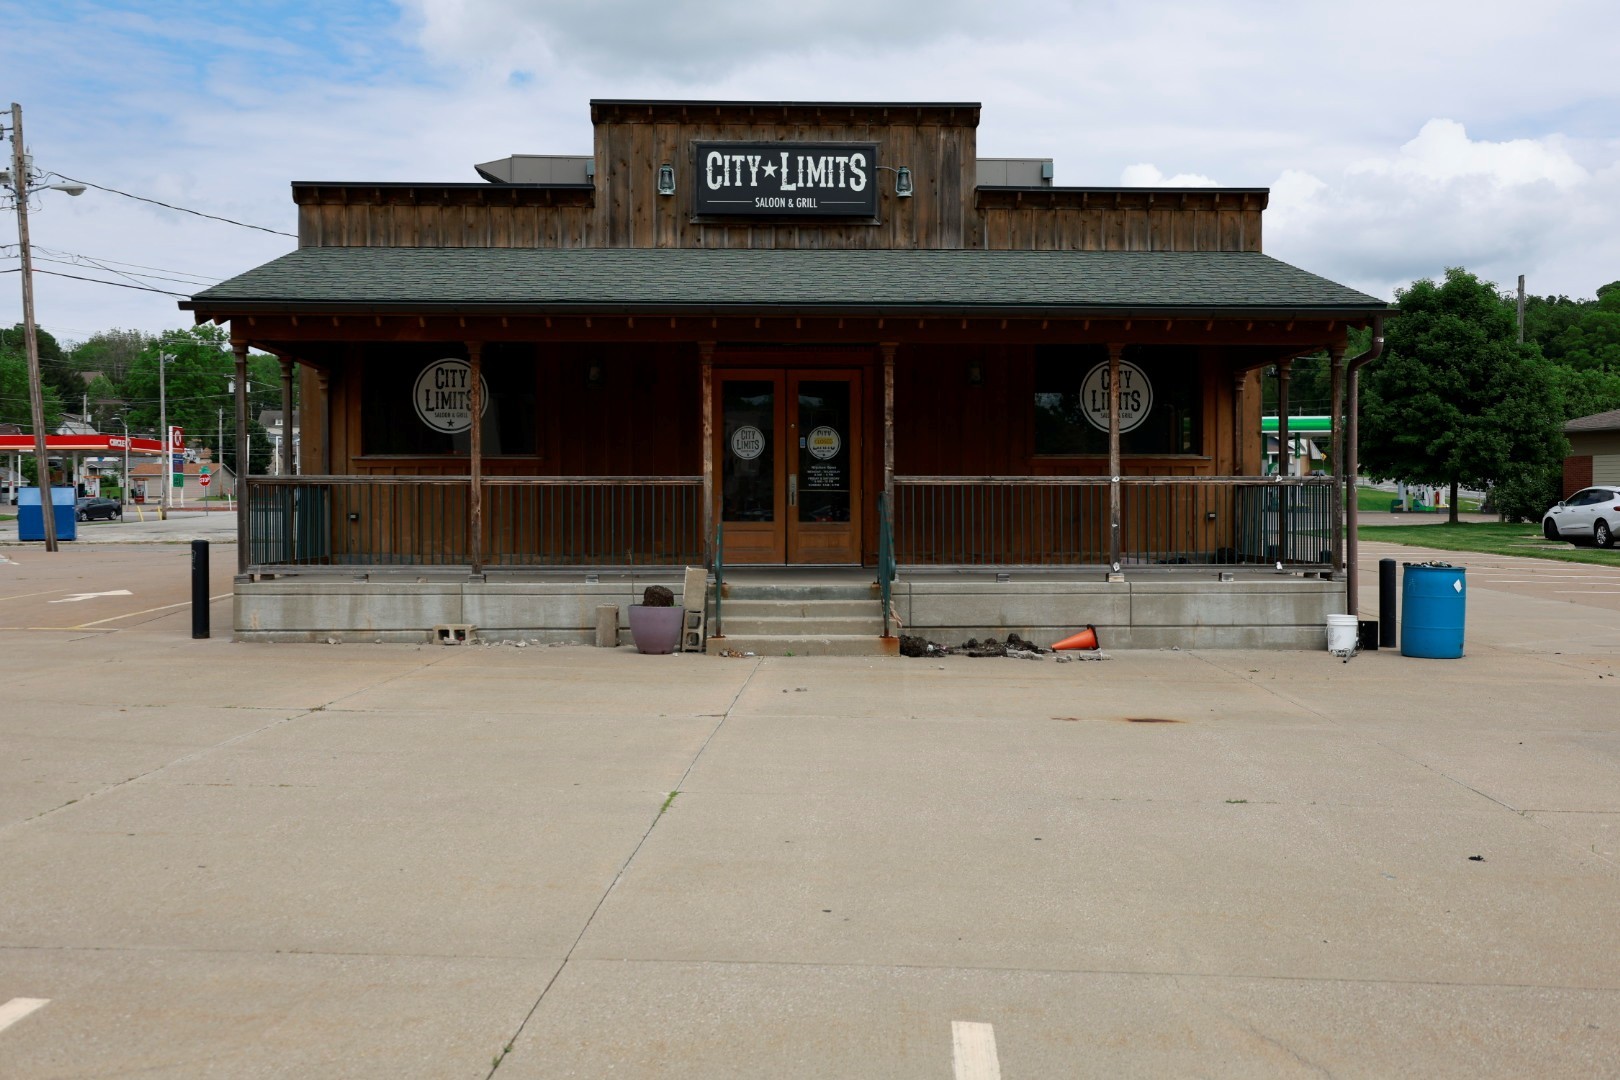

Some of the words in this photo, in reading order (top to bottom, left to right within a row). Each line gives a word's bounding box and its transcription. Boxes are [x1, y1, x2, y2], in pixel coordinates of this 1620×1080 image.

[706, 151, 761, 190] CITY
[780, 152, 867, 191] LIMITS
[755, 197, 786, 208] SALOON
[787, 198, 794, 208] &
[796, 197, 818, 208] GRILL
[435, 366, 467, 389] CITY
[1091, 389, 1141, 412] LIITS
[741, 430, 756, 440] CITY
[736, 440, 760, 450] LIMITS
